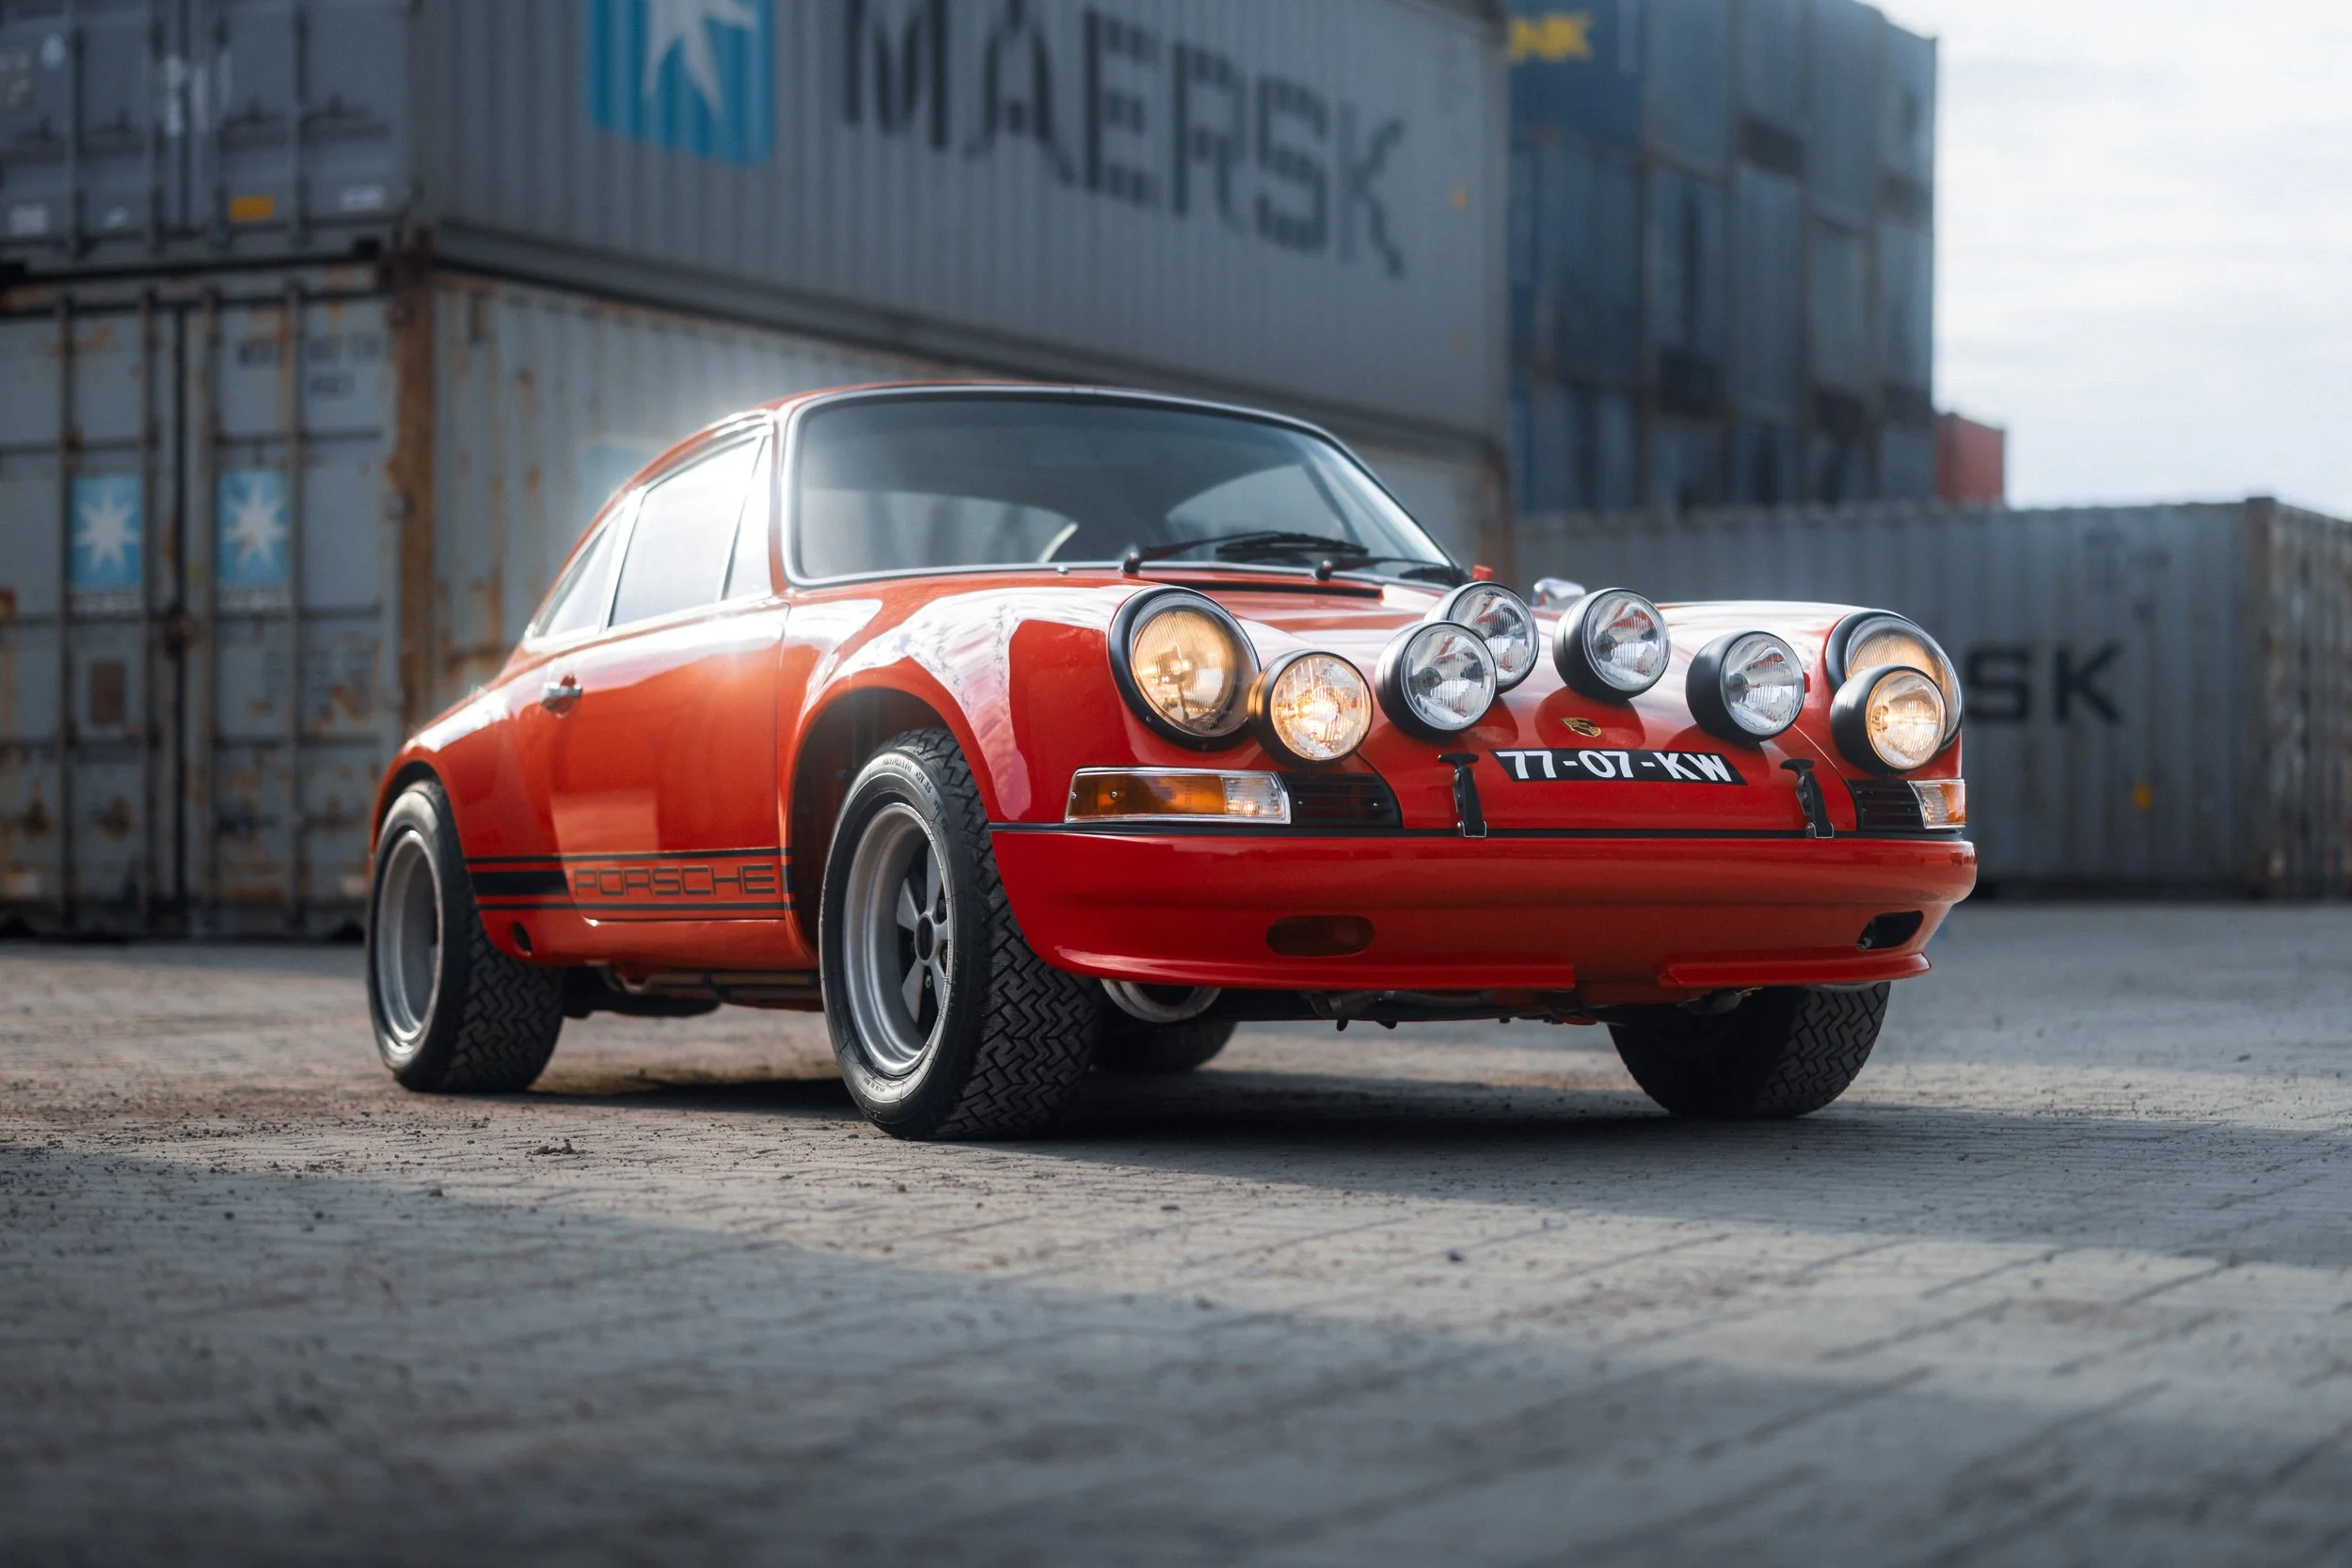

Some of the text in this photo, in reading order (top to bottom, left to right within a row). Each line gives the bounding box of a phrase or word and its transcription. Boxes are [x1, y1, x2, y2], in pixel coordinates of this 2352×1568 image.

[843, 0, 1405, 280] MAERSK
[1495, 750, 1732, 783] 77-07-KW
[573, 863, 777, 896] PORSCHE
